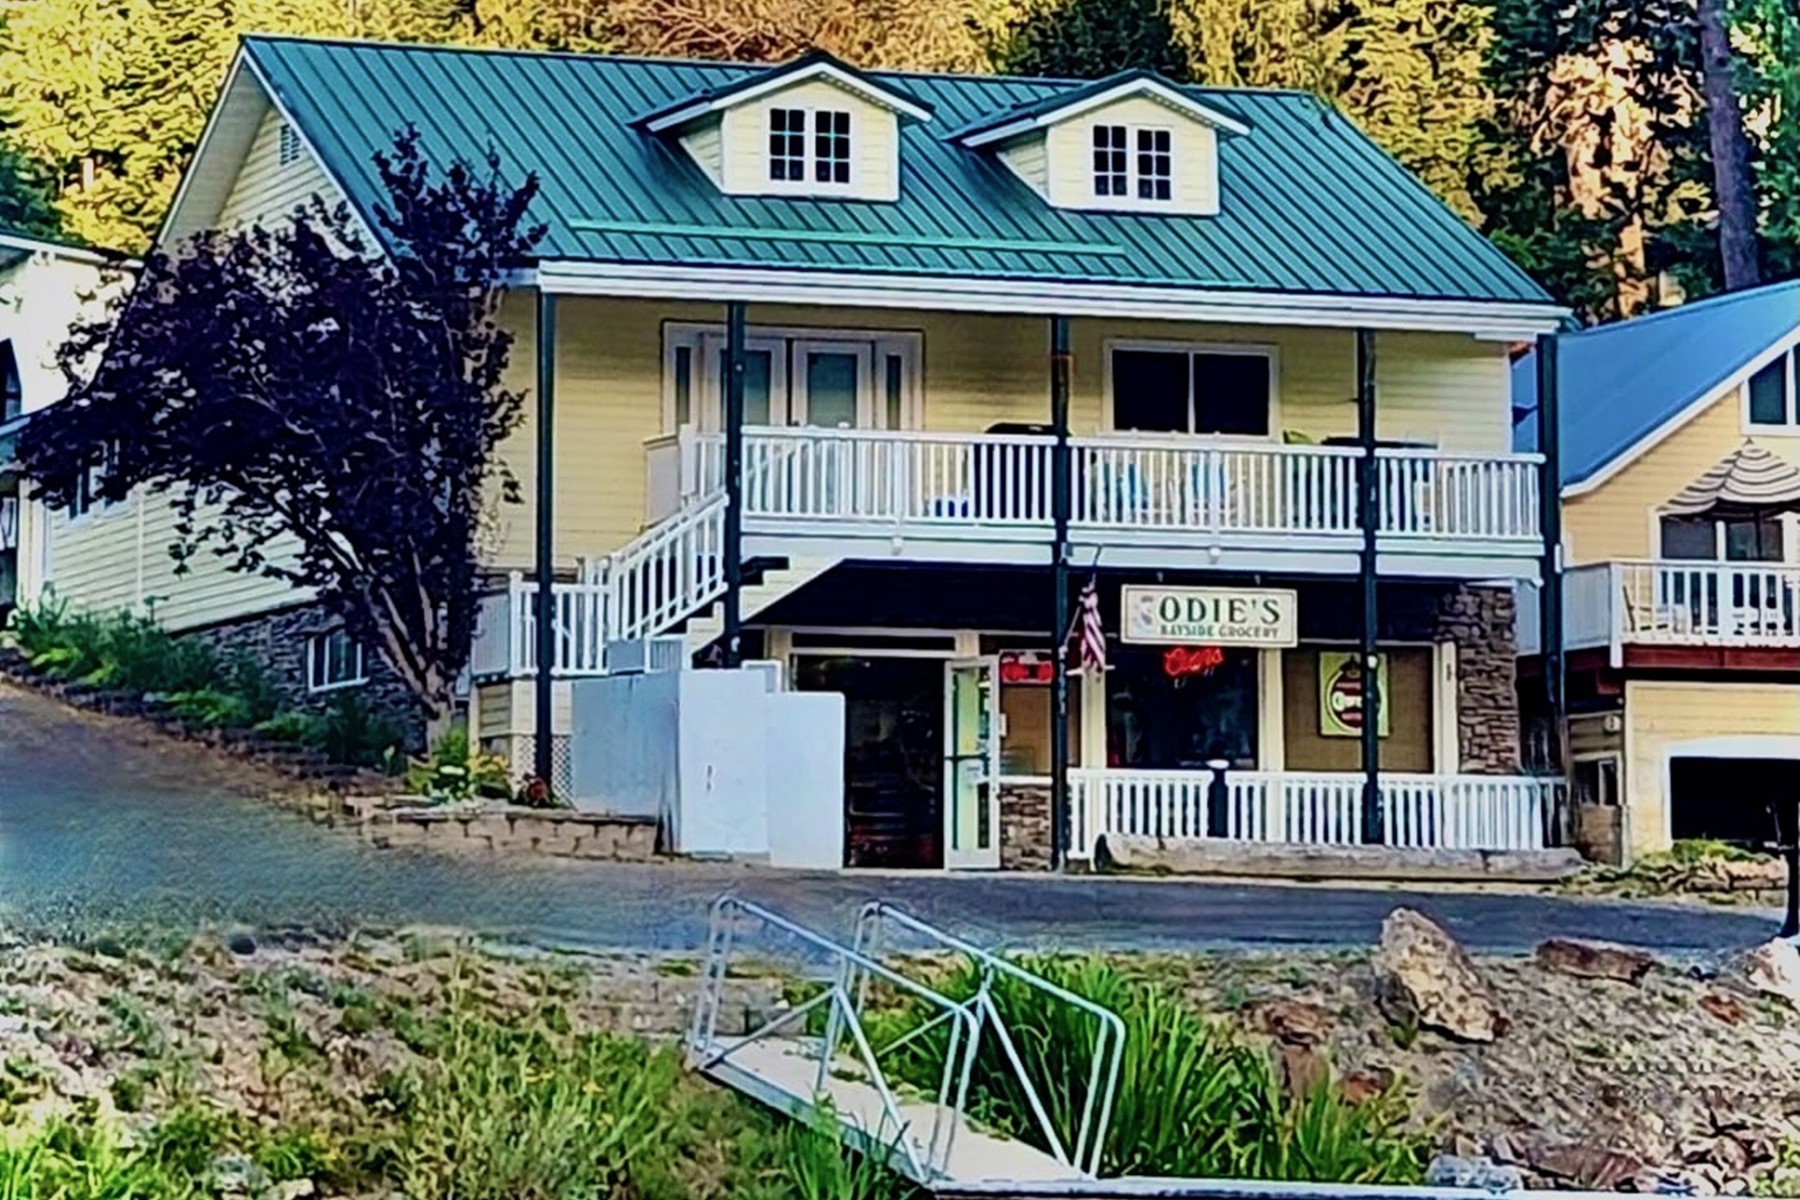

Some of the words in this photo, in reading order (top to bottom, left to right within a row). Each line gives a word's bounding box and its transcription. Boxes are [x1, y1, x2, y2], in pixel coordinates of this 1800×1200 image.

[1160, 596, 1280, 625] ODIE'S
[1160, 625, 1215, 637] BAYSIDE
[1219, 626, 1279, 638] GROCERY
